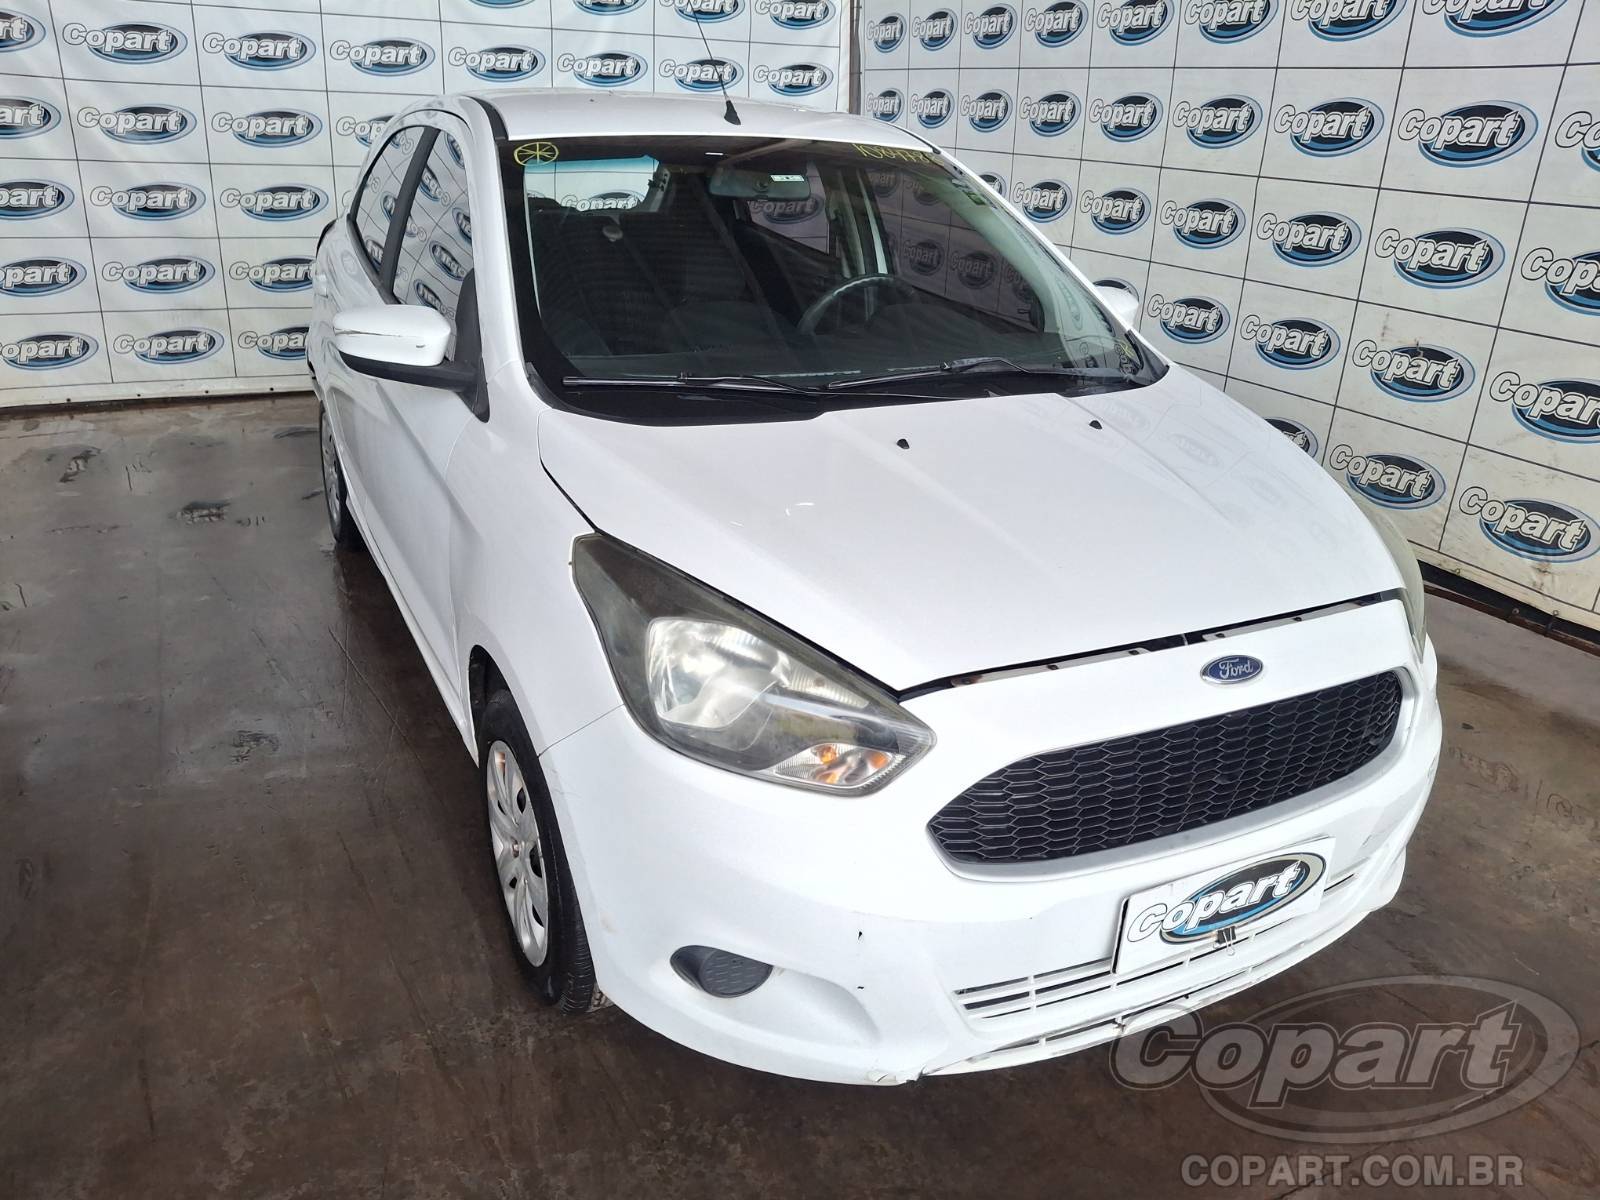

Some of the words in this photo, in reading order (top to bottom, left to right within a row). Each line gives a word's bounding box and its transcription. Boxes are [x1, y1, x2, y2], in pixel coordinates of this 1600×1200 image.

[756, 0, 826, 20] Copart
[964, 9, 1012, 40] Copart
[1025, 4, 1080, 38] Copart
[1100, 0, 1164, 35] Copart
[1184, 0, 1265, 31] Copart
[63, 22, 172, 53] Copart
[866, 17, 902, 42] Copart
[912, 13, 952, 41] Copart
[203, 32, 301, 61] Copart
[330, 40, 422, 67] Copart
[448, 47, 533, 74] Copart
[557, 53, 636, 77] Copart
[659, 59, 733, 83] Copart
[754, 65, 824, 87] Copart
[77, 104, 184, 135] Copart
[865, 92, 901, 119] Copart
[910, 92, 949, 119] Copart
[960, 93, 1008, 120] Copart
[1019, 94, 1075, 125] Copart
[1089, 97, 1154, 129] Copart
[1173, 101, 1252, 137] Copart
[212, 111, 309, 138] Copart
[336, 116, 387, 141] Cop
[1274, 104, 1370, 144] Copart
[1399, 109, 1519, 152] Copart
[90, 185, 193, 212] Copart
[220, 187, 315, 212] Copart
[1013, 181, 1067, 214] Copart
[1080, 191, 1145, 222] Copart
[1161, 200, 1235, 236] Copart
[1256, 212, 1349, 252] Copart
[1375, 228, 1488, 274] Copart
[0, 263, 71, 289] part
[102, 257, 201, 287] Copart
[1521, 247, 1600, 295] Cop
[1148, 294, 1221, 333] Copart
[0, 336, 81, 364] opart
[113, 330, 210, 357] Copart
[238, 331, 307, 353] Copa
[1241, 315, 1330, 357] Copart
[1352, 340, 1461, 390] Copart
[1490, 371, 1600, 428] Copar
[1330, 444, 1431, 500] Copart
[1459, 486, 1586, 552] Copart
[1219, 658, 1254, 679] Ford
[1127, 860, 1302, 942] Copart
